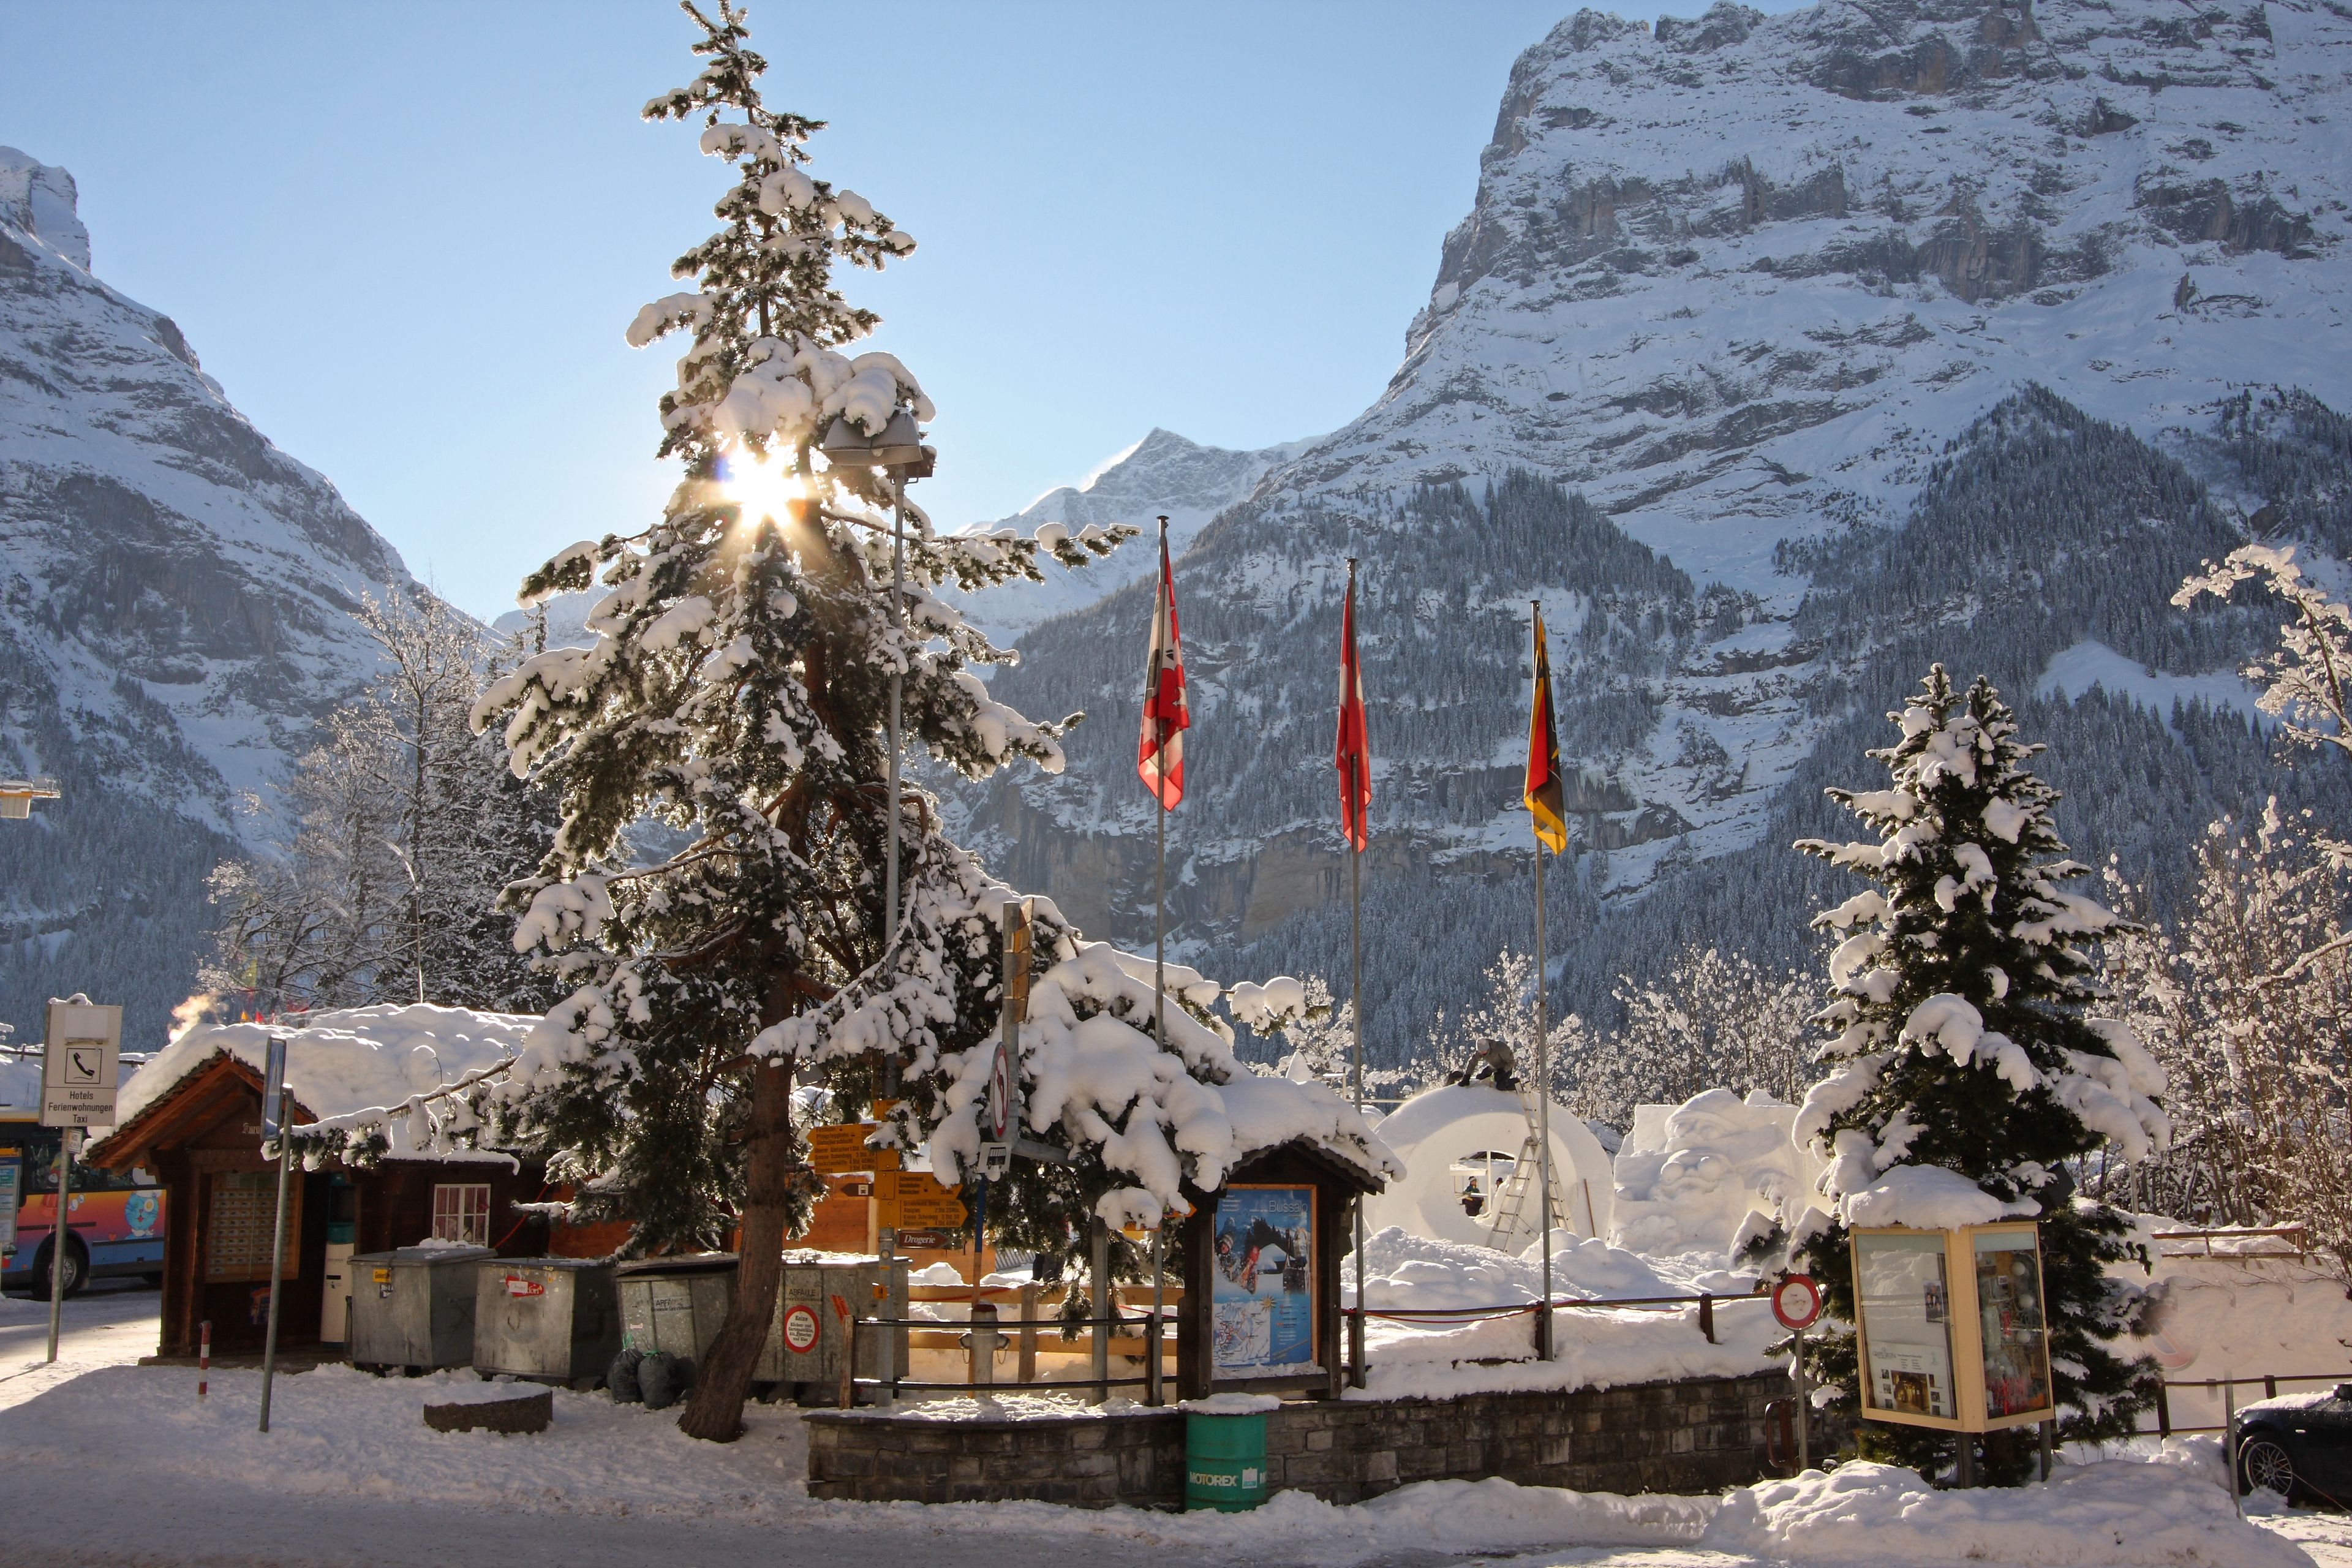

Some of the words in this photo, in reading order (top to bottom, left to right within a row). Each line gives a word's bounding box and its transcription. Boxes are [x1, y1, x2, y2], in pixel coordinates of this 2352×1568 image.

[70, 1091, 94, 1099] Hotels
[48, 1102, 113, 1114] Ferienwohnungen
[73, 1114, 88, 1123] Taxi
[904, 1234, 936, 1245] Drogerie
[1189, 1471, 1237, 1487] MOTOREX
